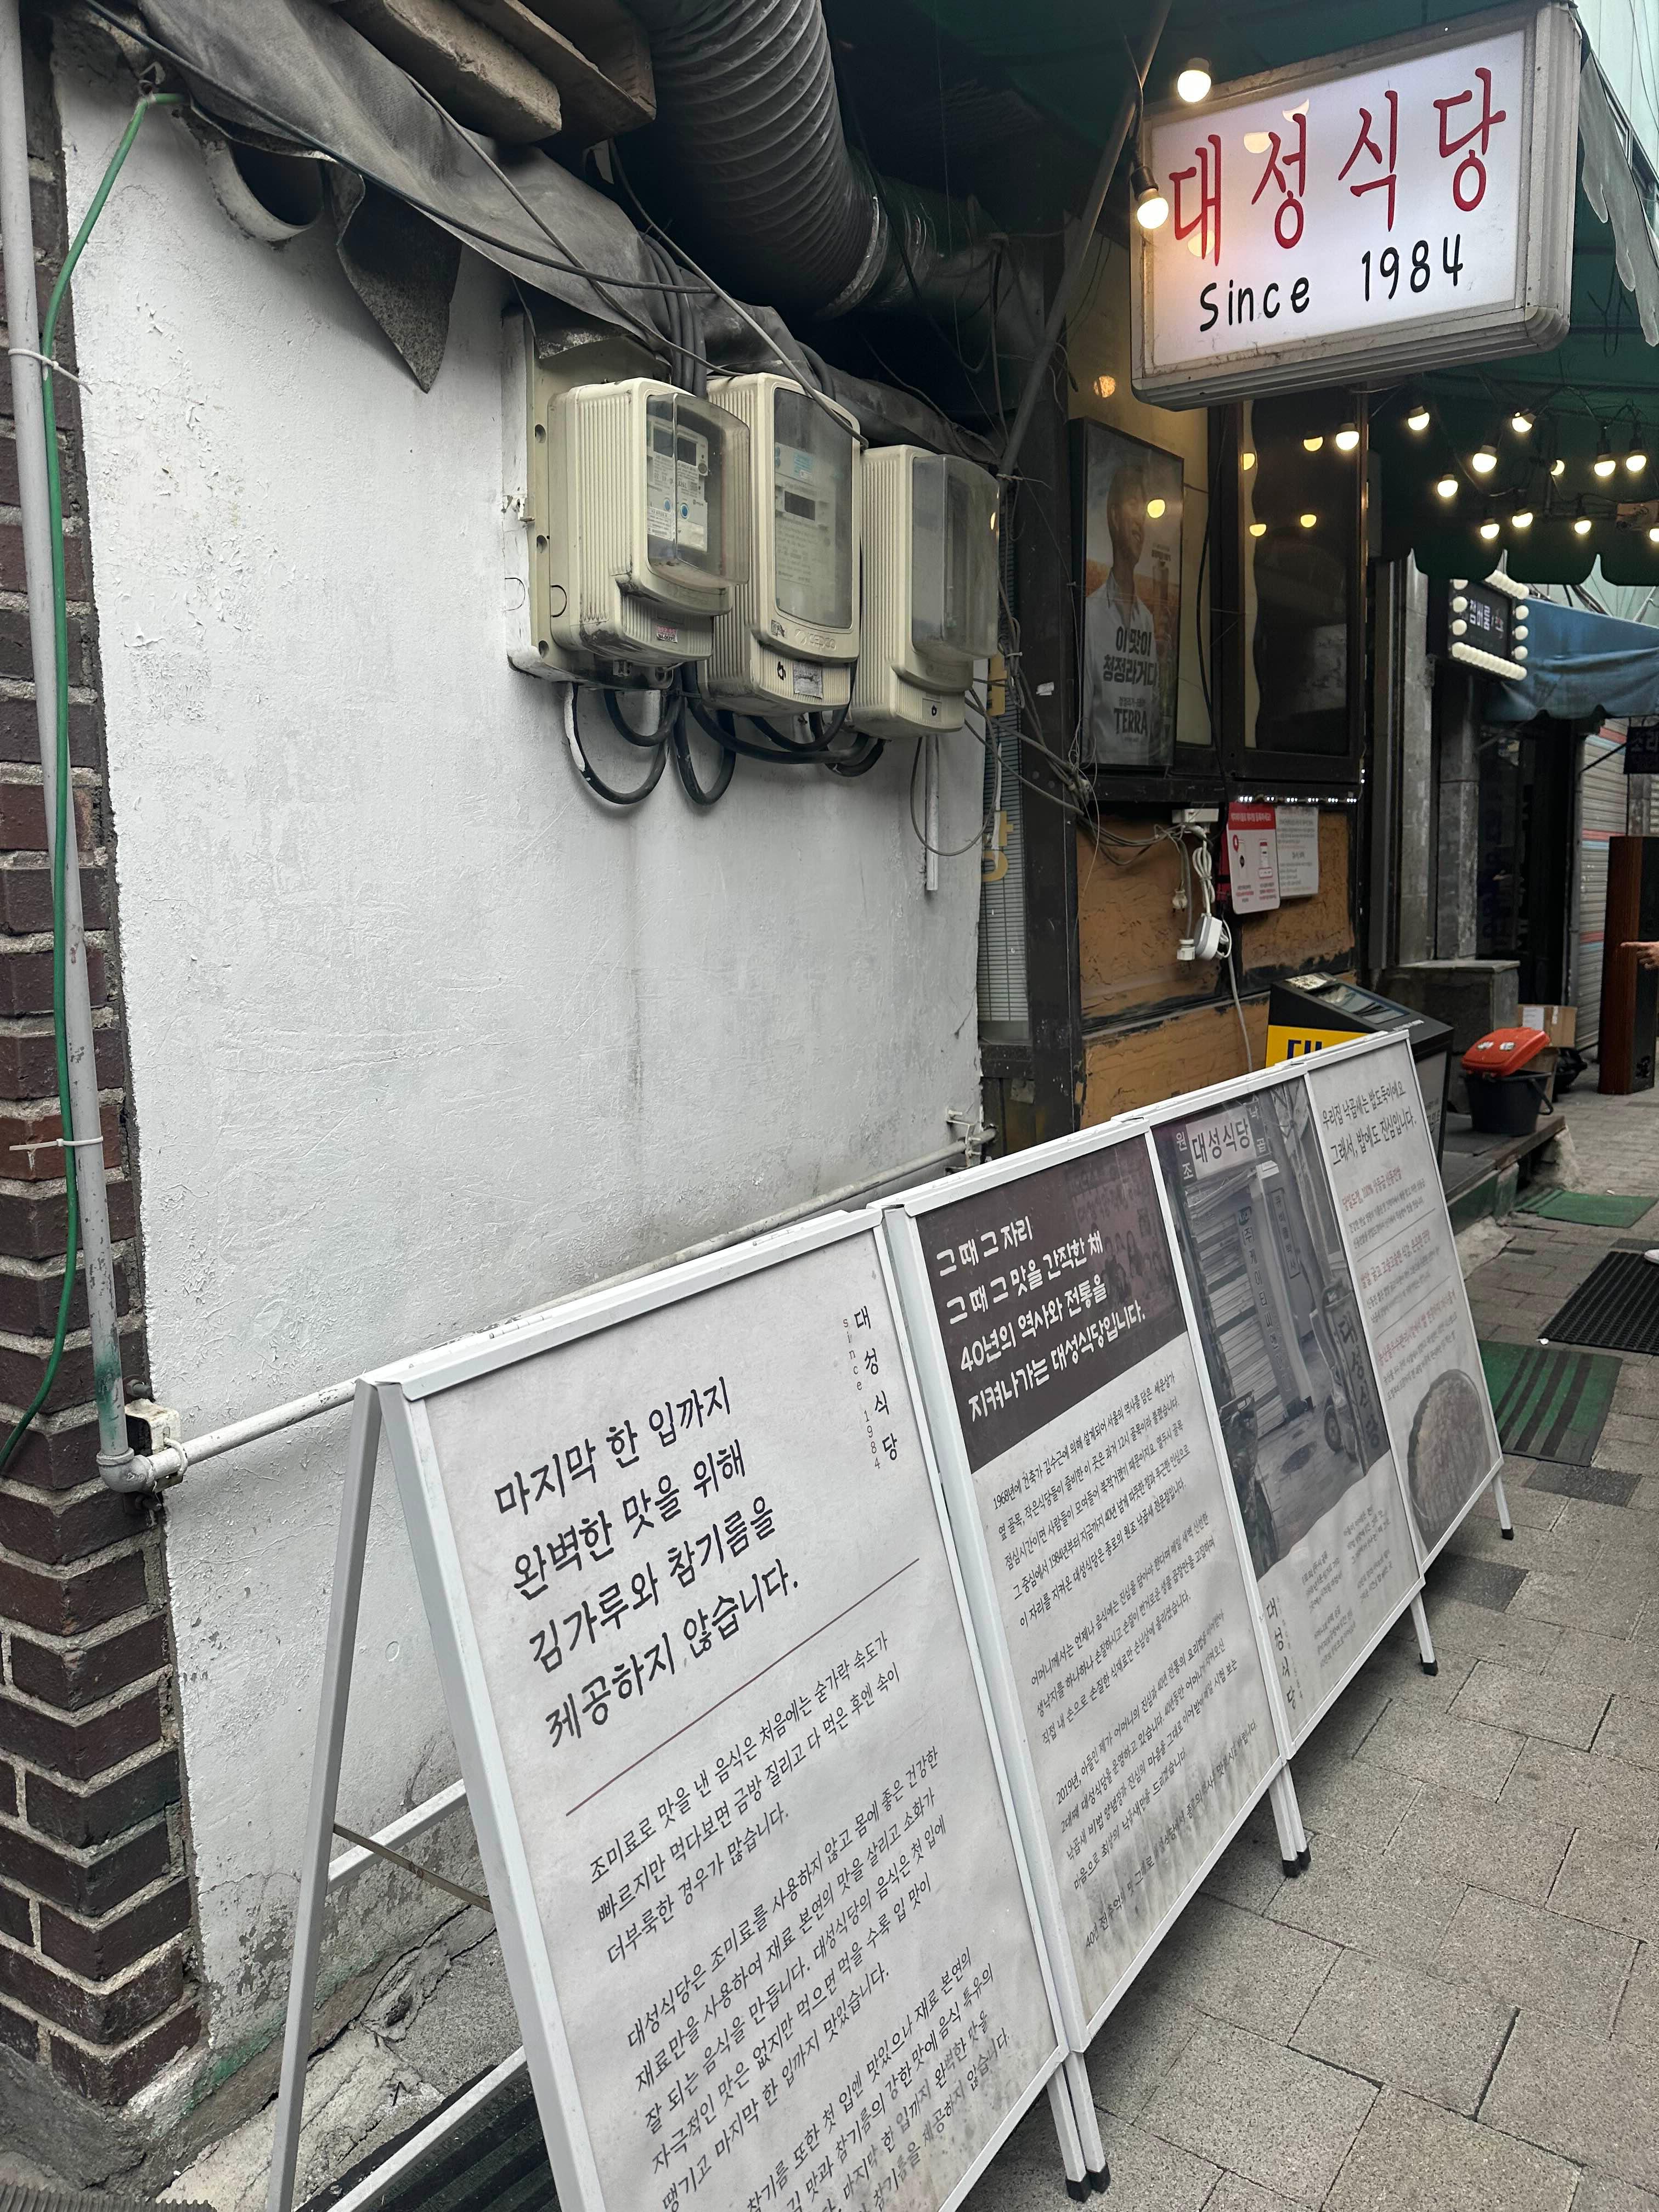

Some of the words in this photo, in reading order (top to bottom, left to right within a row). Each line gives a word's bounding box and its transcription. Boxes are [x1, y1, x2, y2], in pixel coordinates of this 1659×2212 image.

[1168, 66, 1507, 267] 대성식당
[1199, 275, 1311, 332] Since
[1361, 233, 1464, 302] 1984
[1103, 654, 1158, 686] 청정라거다
[1113, 707, 1148, 738] TERRA
[1192, 1118, 1250, 1163] 대성식당
[1322, 1102, 1344, 1130] 우리집
[1341, 1094, 1370, 1120] 낙곱새는
[1330, 1132, 1358, 1166] 그래서,
[1355, 1124, 1381, 1155] 밥에도
[1379, 1105, 1417, 1142] 진심입니다.
[936, 1248, 957, 1277] 그
[958, 1238, 979, 1266] 때
[980, 1231, 999, 1257] 그
[1000, 1215, 1033, 1250] 자리
[946, 1295, 968, 1324] 그
[968, 1284, 989, 1312] 때
[989, 1276, 1009, 1304] 그
[1009, 1259, 1043, 1296] 맛을
[1042, 1237, 1087, 1280] 간직한
[1087, 1229, 1103, 1256] 채
[960, 1321, 1017, 1372] 40년의
[1017, 1296, 1063, 1338] 역사와
[1064, 1273, 1107, 1318] 전통을
[843, 1318, 862, 1391] since
[864, 1409, 881, 1470] 1984
[854, 1305, 898, 1461] 대성식당
[968, 1358, 1049, 1423] 지켜나가는
[1049, 1299, 1146, 1371] 대성식당입니다.
[494, 1437, 596, 1515] 마지막
[605, 1419, 640, 1469] 한
[648, 1375, 730, 1447] 입까지
[992, 1478, 1022, 1510] 1968년에
[1021, 1463, 1043, 1490] 건축가
[1042, 1444, 1070, 1475] 김수근에
[1069, 1434, 1084, 1454] 의해
[1083, 1418, 1107, 1446] 설계되어
[1107, 1406, 1124, 1427] 서울의
[1124, 1394, 1141, 1415] 역사를
[1139, 1387, 1152, 1405] 담은
[1154, 1370, 1175, 1393] 세운상가
[997, 1522, 1008, 1542] 옆
[1007, 1511, 1025, 1535] 골목,
[1023, 1479, 1065, 1520] 작은식당들이
[1064, 1465, 1085, 1493] 즐비한
[1083, 1459, 1092, 1475] 이
[1091, 1451, 1105, 1472] 곳은
[1104, 1440, 1118, 1459] 과거
[1116, 1430, 1131, 1450] 12시
[1129, 1413, 1153, 1442] 골목이라
[1151, 1395, 1180, 1425] 불렸습니다.
[513, 1509, 614, 1601] 완벽한
[622, 1474, 681, 1539] 맛을
[692, 1438, 746, 1498] 위해
[528, 1561, 659, 1673] 김가루와
[667, 1496, 776, 1588] 참기름을
[1019, 1610, 1029, 1628] 이
[1028, 1591, 1052, 1621] 자리를
[1051, 1575, 1073, 1601] 지켜온
[1072, 1547, 1105, 1584] 대성식당은
[1104, 1528, 1124, 1557] 종로의
[1123, 1520, 1137, 1540] 원조
[1136, 1502, 1154, 1528] 낙곱새
[1152, 1476, 1187, 1514] 전문점입니다.
[545, 1631, 675, 1748] 제공하지
[682, 1558, 798, 1658] 않습니다.
[1266, 1596, 1296, 1710] 대성식당
[589, 1816, 657, 1884] 조미료로
[657, 1786, 691, 1829] 맛을
[693, 1769, 712, 1798] 낸
[714, 1736, 757, 1785] 음식은
[758, 1696, 812, 1745] 처음에는
[814, 1658, 850, 1704] 숟가락
[853, 1630, 888, 1669] 속도가
[596, 1853, 666, 1922] 빠르지만
[669, 1799, 732, 1861] 먹다보면
[733, 1774, 762, 1815] 금방
[764, 1742, 806, 1787] 질리고
[806, 1726, 821, 1750] 다
[822, 1706, 849, 1735] 먹은
[849, 1681, 875, 1716] 후엔
[876, 1661, 900, 1692] 속이
[606, 1893, 674, 1963] 더부룩한
[677, 1852, 724, 1905] 경우가
[726, 1801, 788, 1866] 많습니다.
[627, 1963, 707, 2047] 대성식당은
[710, 1903, 768, 1973] 조미료를
[772, 1850, 823, 1913] 사용하지
[824, 1828, 853, 1865] 않고
[854, 1799, 879, 1838] 몸에
[881, 1779, 904, 1812] 좋은
[905, 1745, 938, 1788] 건강한
[635, 2015, 699, 2092] 재료만을
[703, 1951, 763, 2023] 사용하여
[765, 1926, 796, 1963] 재료
[798, 1881, 834, 1934] 본연의
[836, 1857, 864, 1895] 맛을
[866, 1822, 901, 1867] 살리고
[903, 1786, 935, 1832] 소화가
[645, 2102, 663, 2135] 잘
[667, 2071, 699, 2112] 되는
[702, 2016, 746, 2075] 음식을
[748, 1955, 810, 2025] 만듭니다.
[812, 1888, 872, 1960] 대성식당의
[875, 1854, 911, 1901] 음식은
[910, 1837, 924, 1864] 첫
[924, 1814, 946, 1850] 입에
[652, 2093, 717, 2174] 자극적인
[717, 2061, 750, 2107] 맛은
[752, 2011, 793, 2071] 없지만
[795, 1967, 837, 2017] 먹으면
[837, 1941, 863, 1974] 먹을
[866, 1912, 891, 1949] 수록
[893, 1897, 906, 1923] 입
[907, 1871, 931, 1910] 맛이
[714, 2097, 759, 2157] 마지막
[761, 2077, 778, 2107] 한
[781, 2028, 820, 2088] 입까지
[822, 1961, 889, 2043] 맛있습니다.
[792, 2123, 820, 2170] 또한
[822, 2102, 836, 2134] 첫
[838, 2070, 864, 2114] 입엔
[866, 2013, 913, 2083] 맛있으나
[913, 1988, 939, 2022] 재료
[940, 1946, 971, 1995] 본연의
[805, 2154, 834, 2203] 맛과
[835, 2092, 885, 2164] 참기름의
[884, 2060, 912, 2100] 강한
[911, 2029, 938, 2072] 맛에
[938, 2001, 961, 2040] 음식
[962, 1962, 994, 2007] 특유의
[842, 2143, 878, 2200] 마지막
[880, 2125, 895, 2153] 한
[895, 2078, 931, 2134] 입까지
[934, 2036, 967, 2089] 완벽한
[967, 2009, 988, 2045] 맛을
